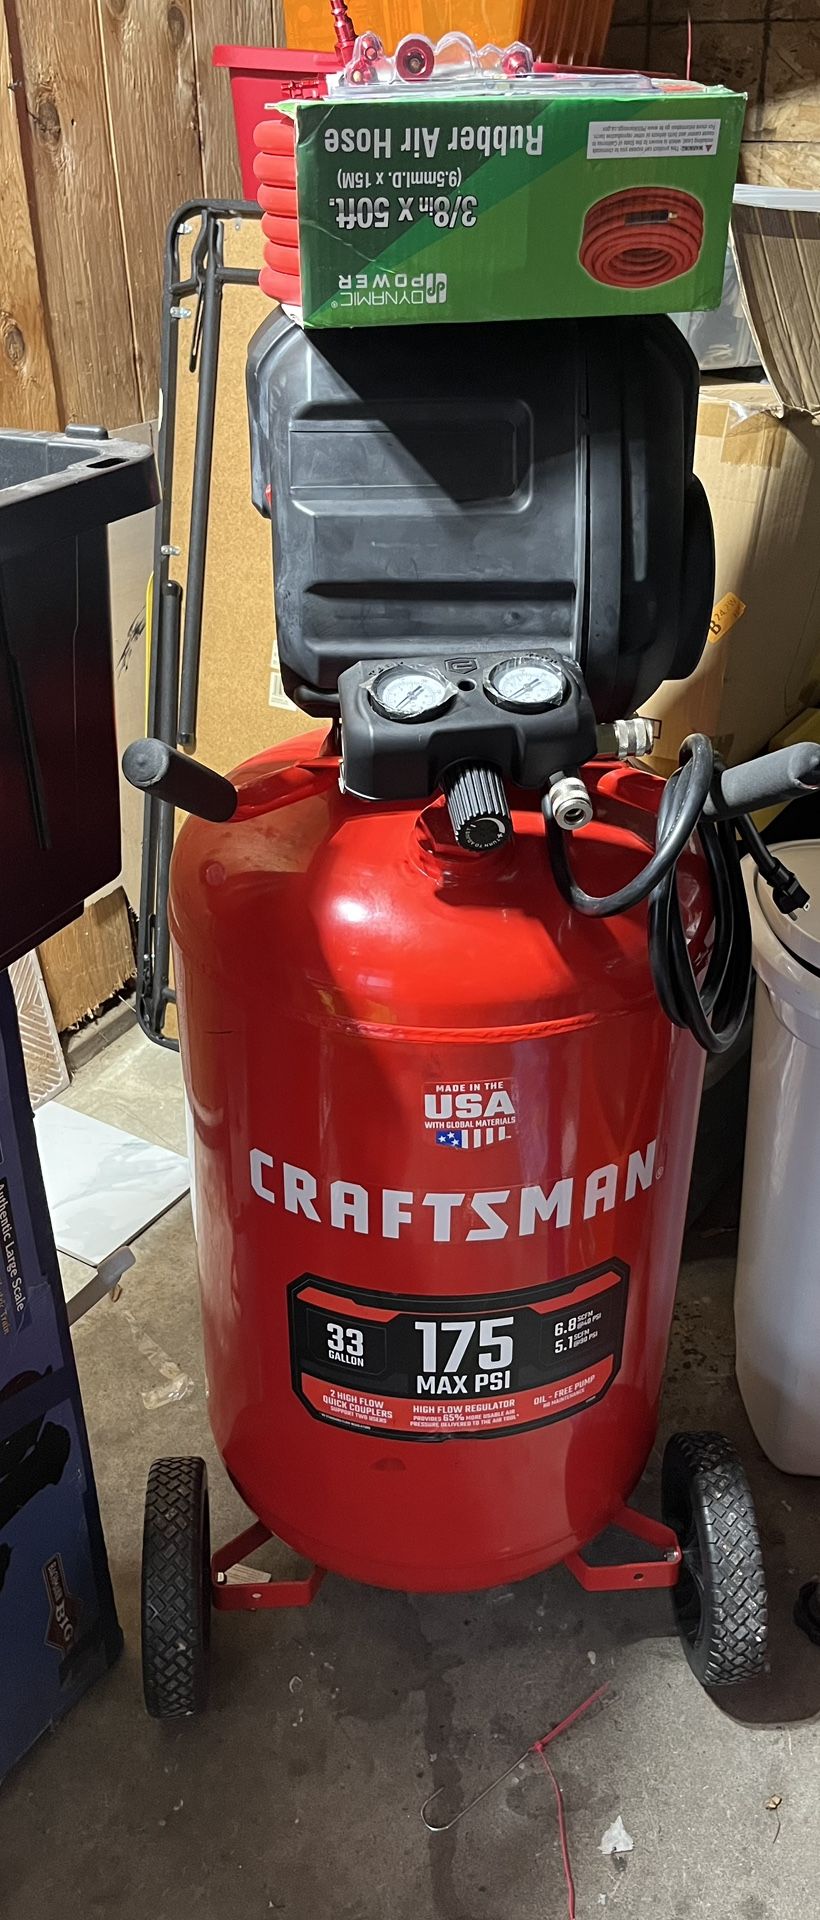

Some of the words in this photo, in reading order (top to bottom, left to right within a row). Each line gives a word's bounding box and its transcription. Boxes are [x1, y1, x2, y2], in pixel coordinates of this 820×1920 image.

[324, 127, 392, 159] Hose
[400, 127, 441, 159] Air
[447, 124, 544, 157] Rubber
[337, 168, 371, 189] 15M)
[375, 172, 384, 185] x
[329, 196, 390, 230] 50ft.
[397, 196, 414, 222] x
[418, 195, 478, 229] 3/8in
[338, 273, 424, 289] POWER
[435, 1084, 466, 1093] MADE
[469, 1083, 481, 1091] IN
[484, 1081, 504, 1090] THE
[424, 1090, 516, 1120] USA
[424, 1121, 445, 1129] WITH
[446, 1121, 474, 1129] GLOBAL
[475, 1116, 516, 1128] MATERIALS
[249, 1138, 658, 1243] CRAFTSMAN
[5, 1241, 18, 1278] Large
[12, 1277, 26, 1312] Scale
[554, 1317, 577, 1336] 6.8
[591, 1312, 602, 1323] PSI
[326, 1322, 364, 1357] 33
[414, 1316, 514, 1373] 175
[554, 1335, 573, 1354] 5.1
[588, 1331, 599, 1341] PSI
[328, 1349, 365, 1368] GALLON
[416, 1375, 469, 1395] MAX
[474, 1370, 511, 1393] PSI
[533, 1395, 547, 1406] OIL
[554, 1384, 574, 1399] FREE
[574, 1374, 596, 1391] PUMP
[322, 1395, 348, 1409] QUICK
[349, 1402, 393, 1419] COUPLERS
[330, 1389, 336, 1398] 2
[337, 1391, 357, 1404] HIGH
[359, 1396, 384, 1409] FLOW
[413, 1405, 435, 1413] HIGH
[437, 1404, 463, 1413] FLOW
[465, 1399, 515, 1411] REGULATOR
[355, 1411, 368, 1420] TWO
[443, 1413, 465, 1422] 65%
[56, 1598, 74, 1642] BIG
